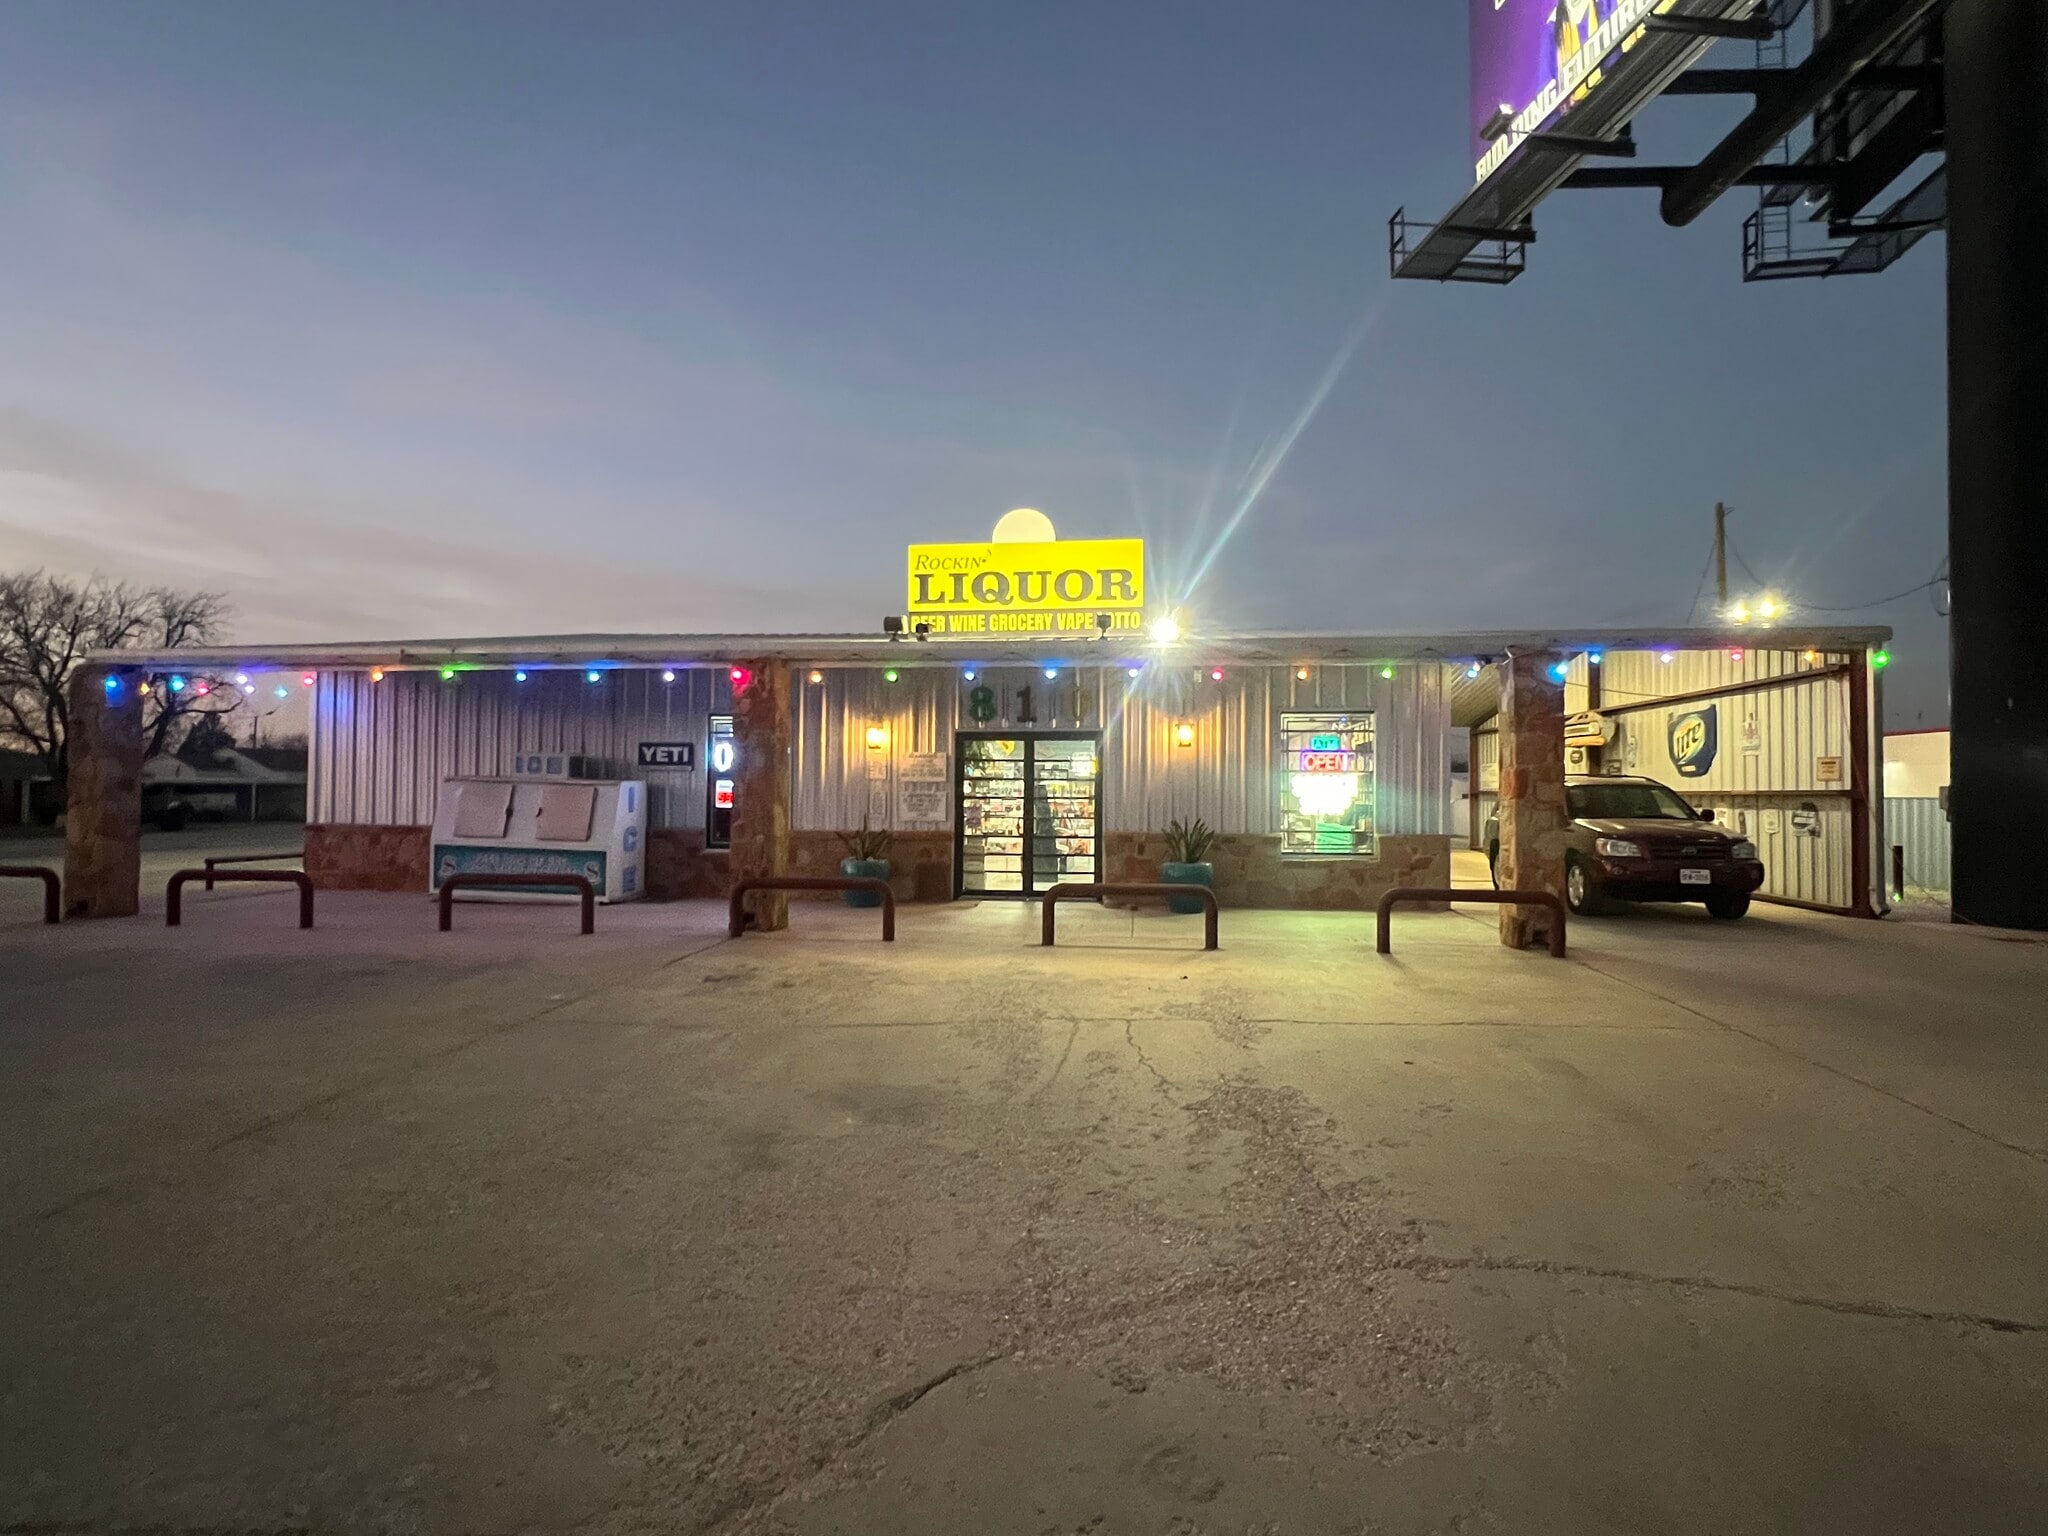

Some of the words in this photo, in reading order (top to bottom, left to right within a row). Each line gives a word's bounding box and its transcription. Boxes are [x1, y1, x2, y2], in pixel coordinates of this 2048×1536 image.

[914, 569, 1138, 605] LIQUOR
[949, 614, 986, 632] WINE
[989, 612, 1053, 632] GROCERY
[1057, 612, 1094, 631] VAPE
[1097, 611, 1141, 629] OTTO
[641, 745, 690, 762] YETI
[1305, 755, 1347, 771] OPEN
